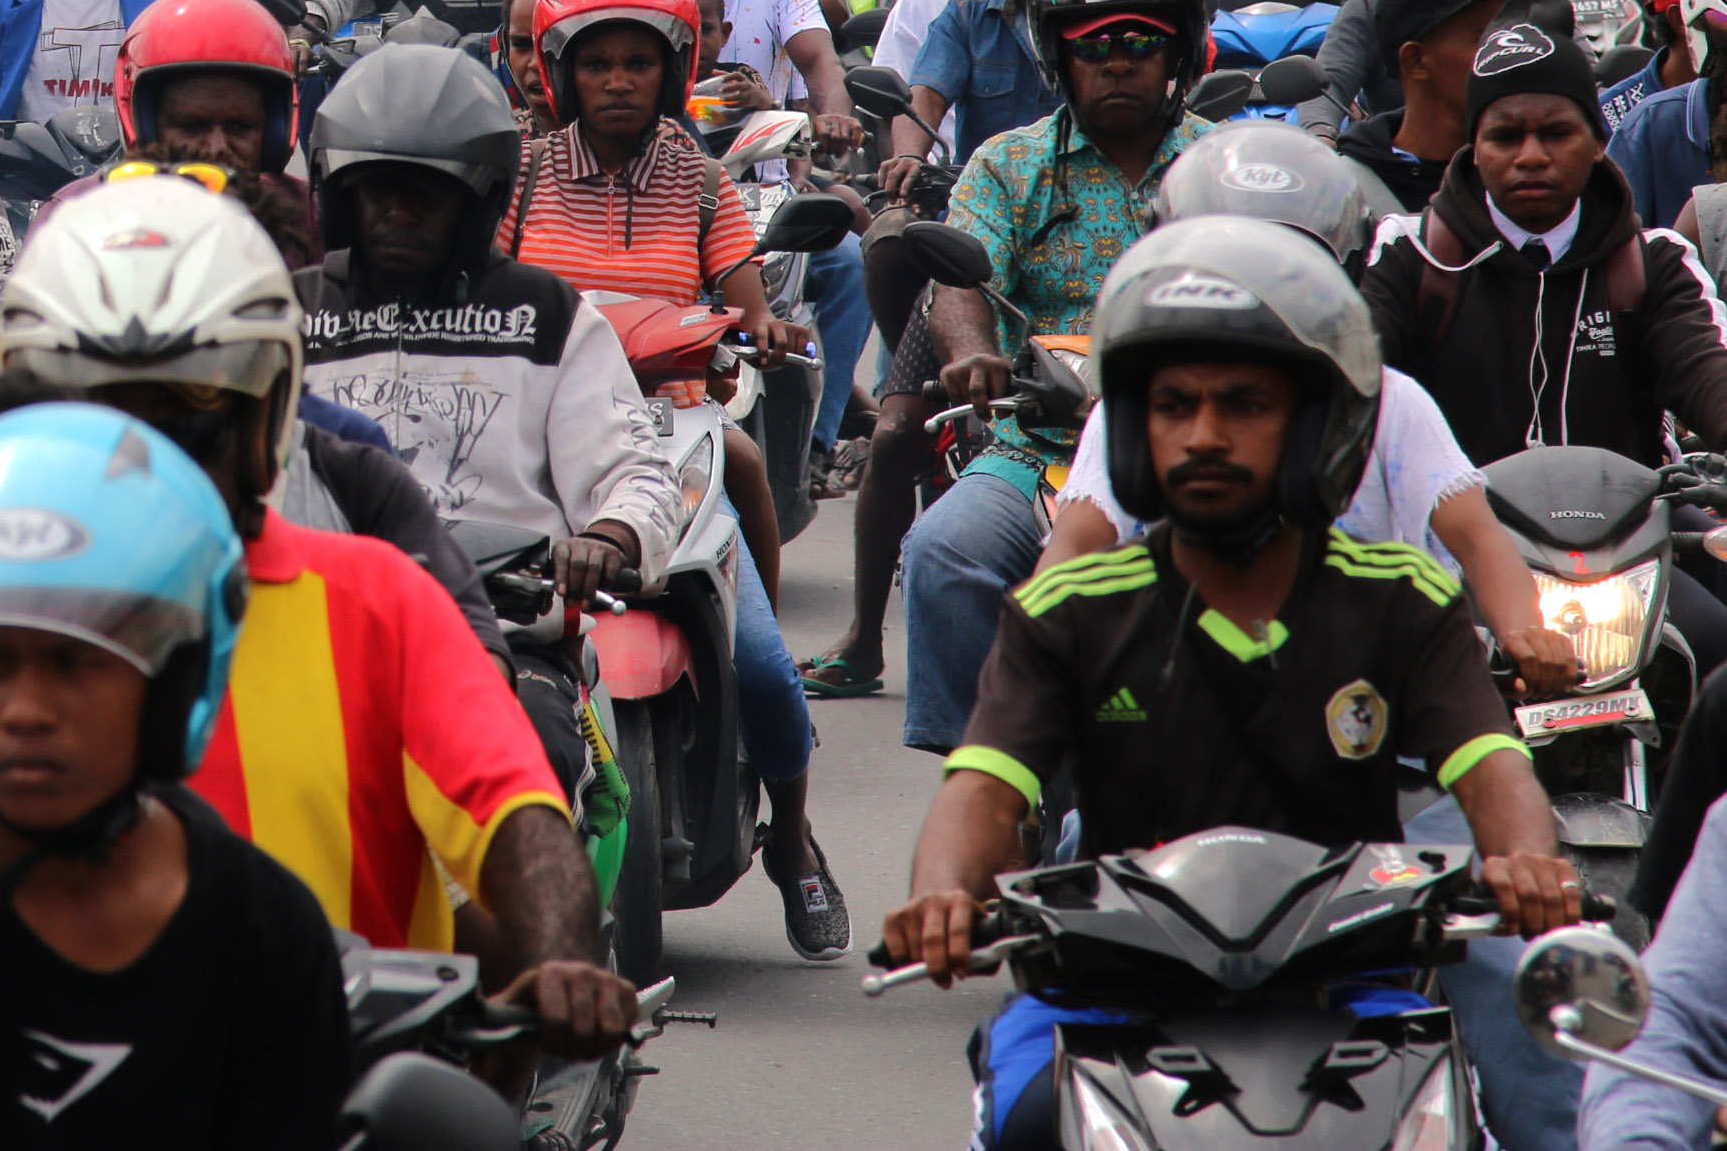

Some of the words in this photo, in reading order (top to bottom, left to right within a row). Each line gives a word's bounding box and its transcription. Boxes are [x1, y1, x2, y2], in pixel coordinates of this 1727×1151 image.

[1244, 167, 1289, 185] Kyt
[1550, 510, 1606, 520] HONDA
[1568, 551, 1591, 575] 2
[1096, 710, 1147, 722] adidas
